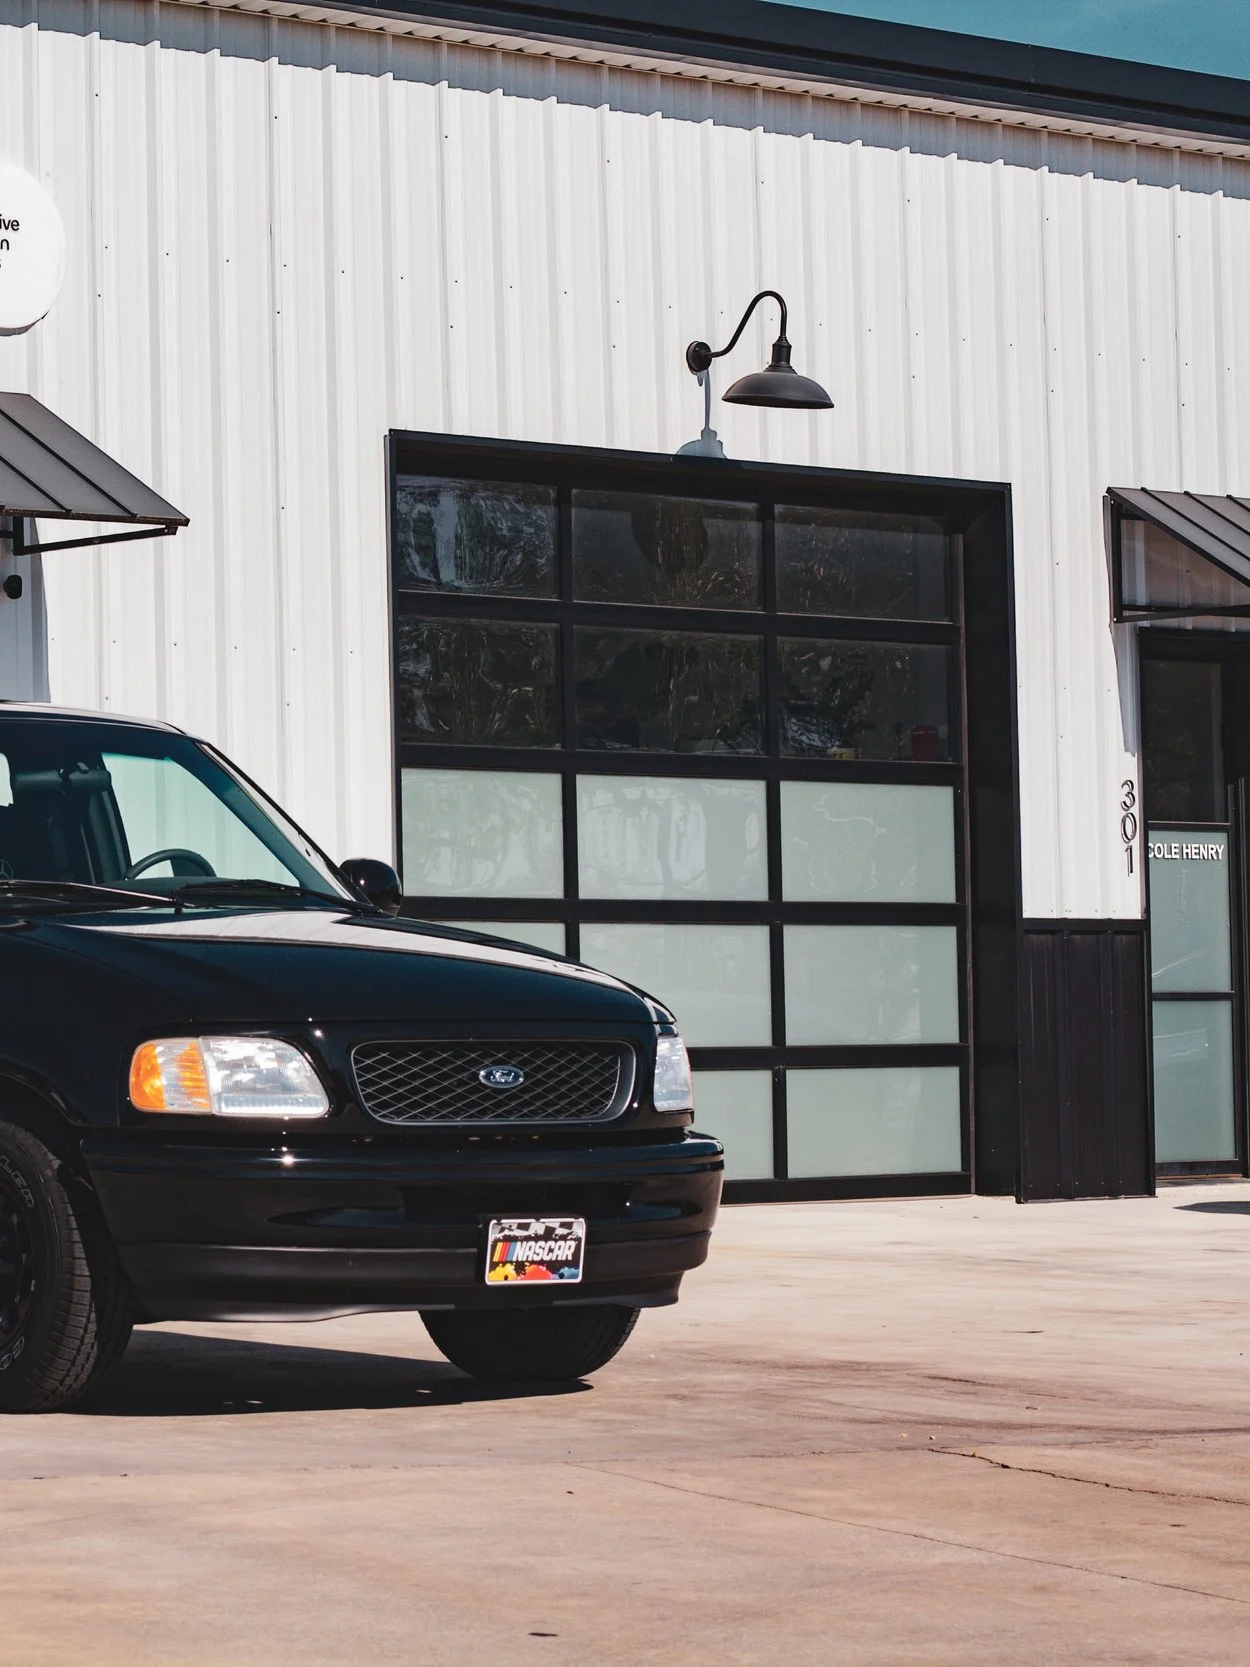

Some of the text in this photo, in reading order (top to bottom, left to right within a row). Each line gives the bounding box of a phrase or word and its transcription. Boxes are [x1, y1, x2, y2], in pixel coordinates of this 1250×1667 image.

[1120, 779, 1138, 877] 301
[1182, 843, 1225, 860] HENRY
[512, 1240, 576, 1261] NASCAR
